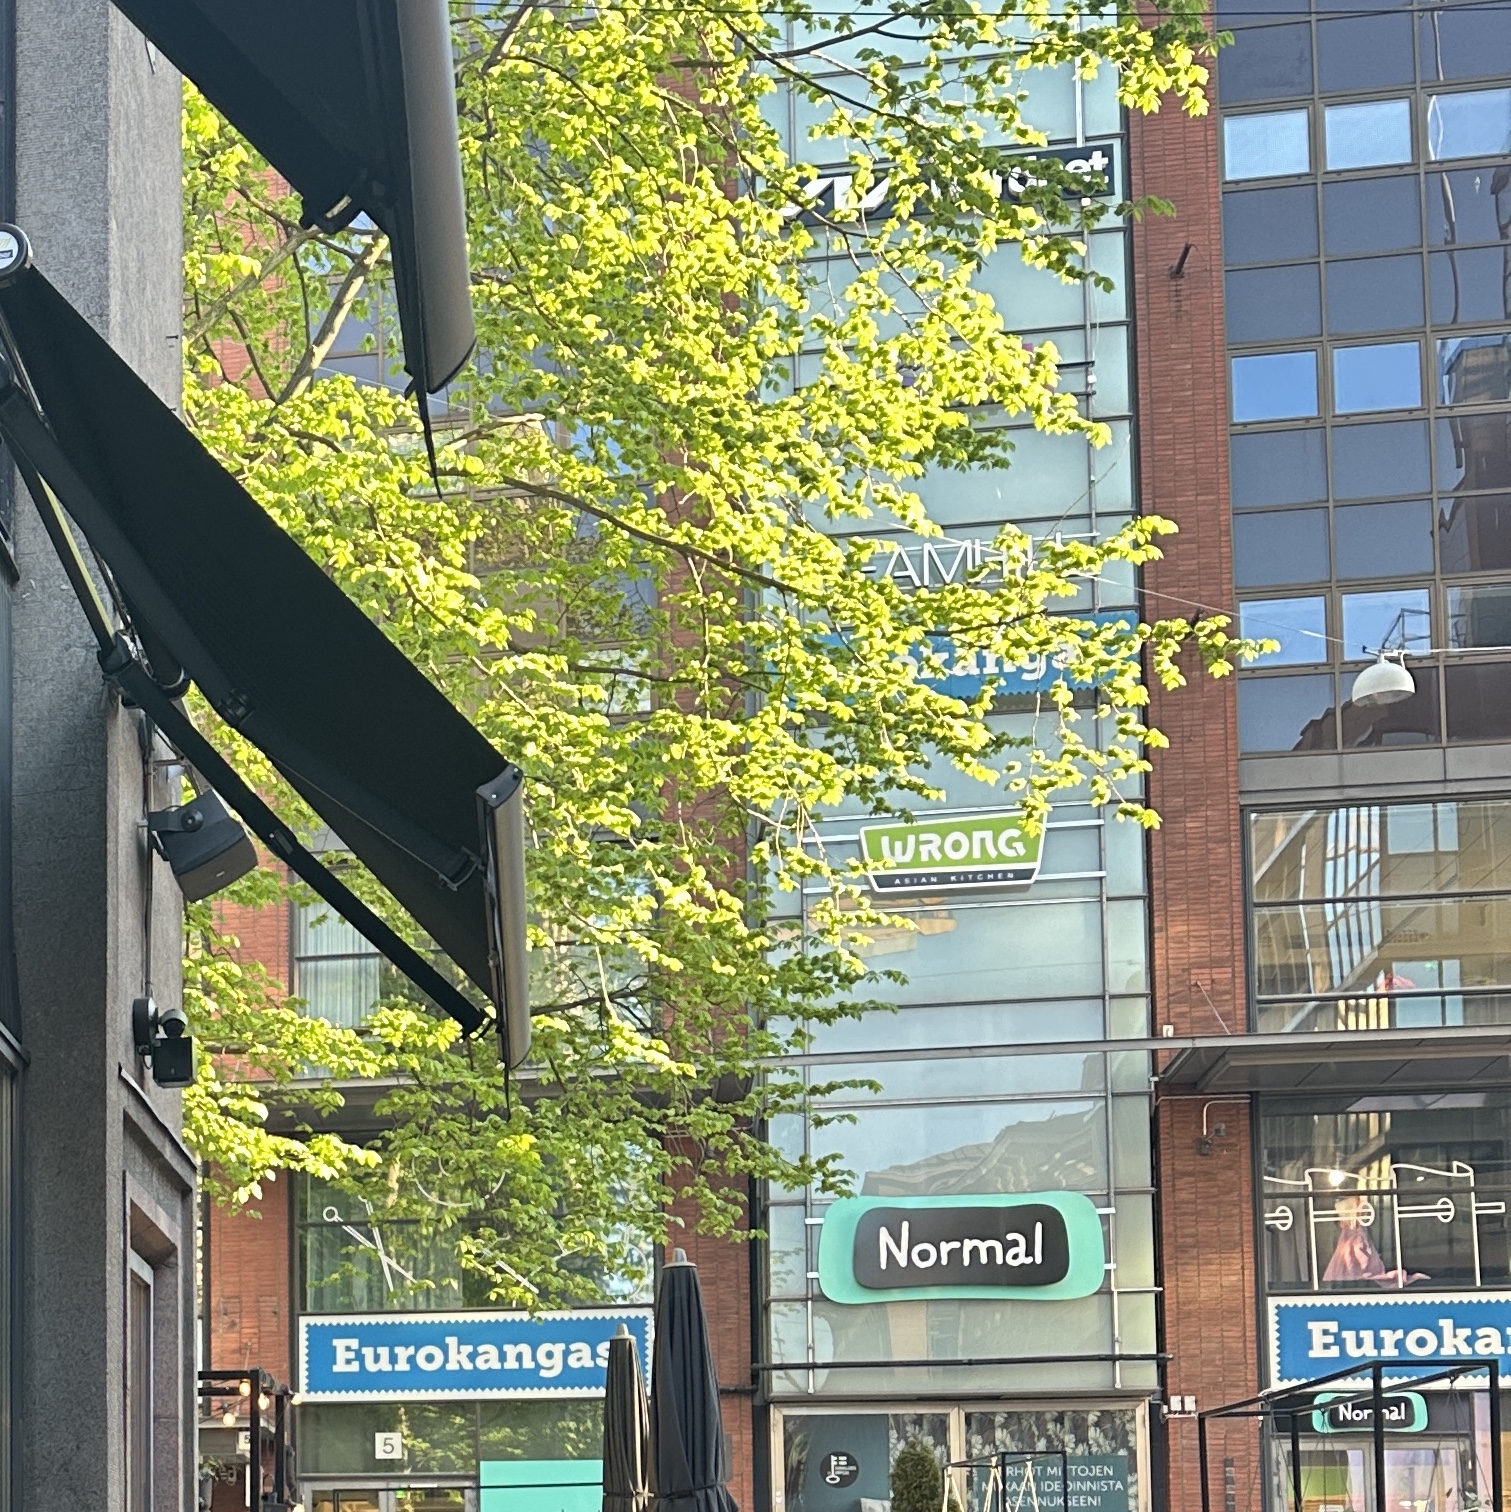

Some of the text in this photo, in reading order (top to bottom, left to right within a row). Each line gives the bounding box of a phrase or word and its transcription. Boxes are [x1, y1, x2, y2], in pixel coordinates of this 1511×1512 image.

[880, 828, 1027, 863] WRONG
[894, 872, 1014, 885] ASIAN KITCHEN
[879, 1220, 1043, 1271] Normal
[382, 1437, 396, 1455] 5
[1046, 1465, 1115, 1478] MITOJEN
